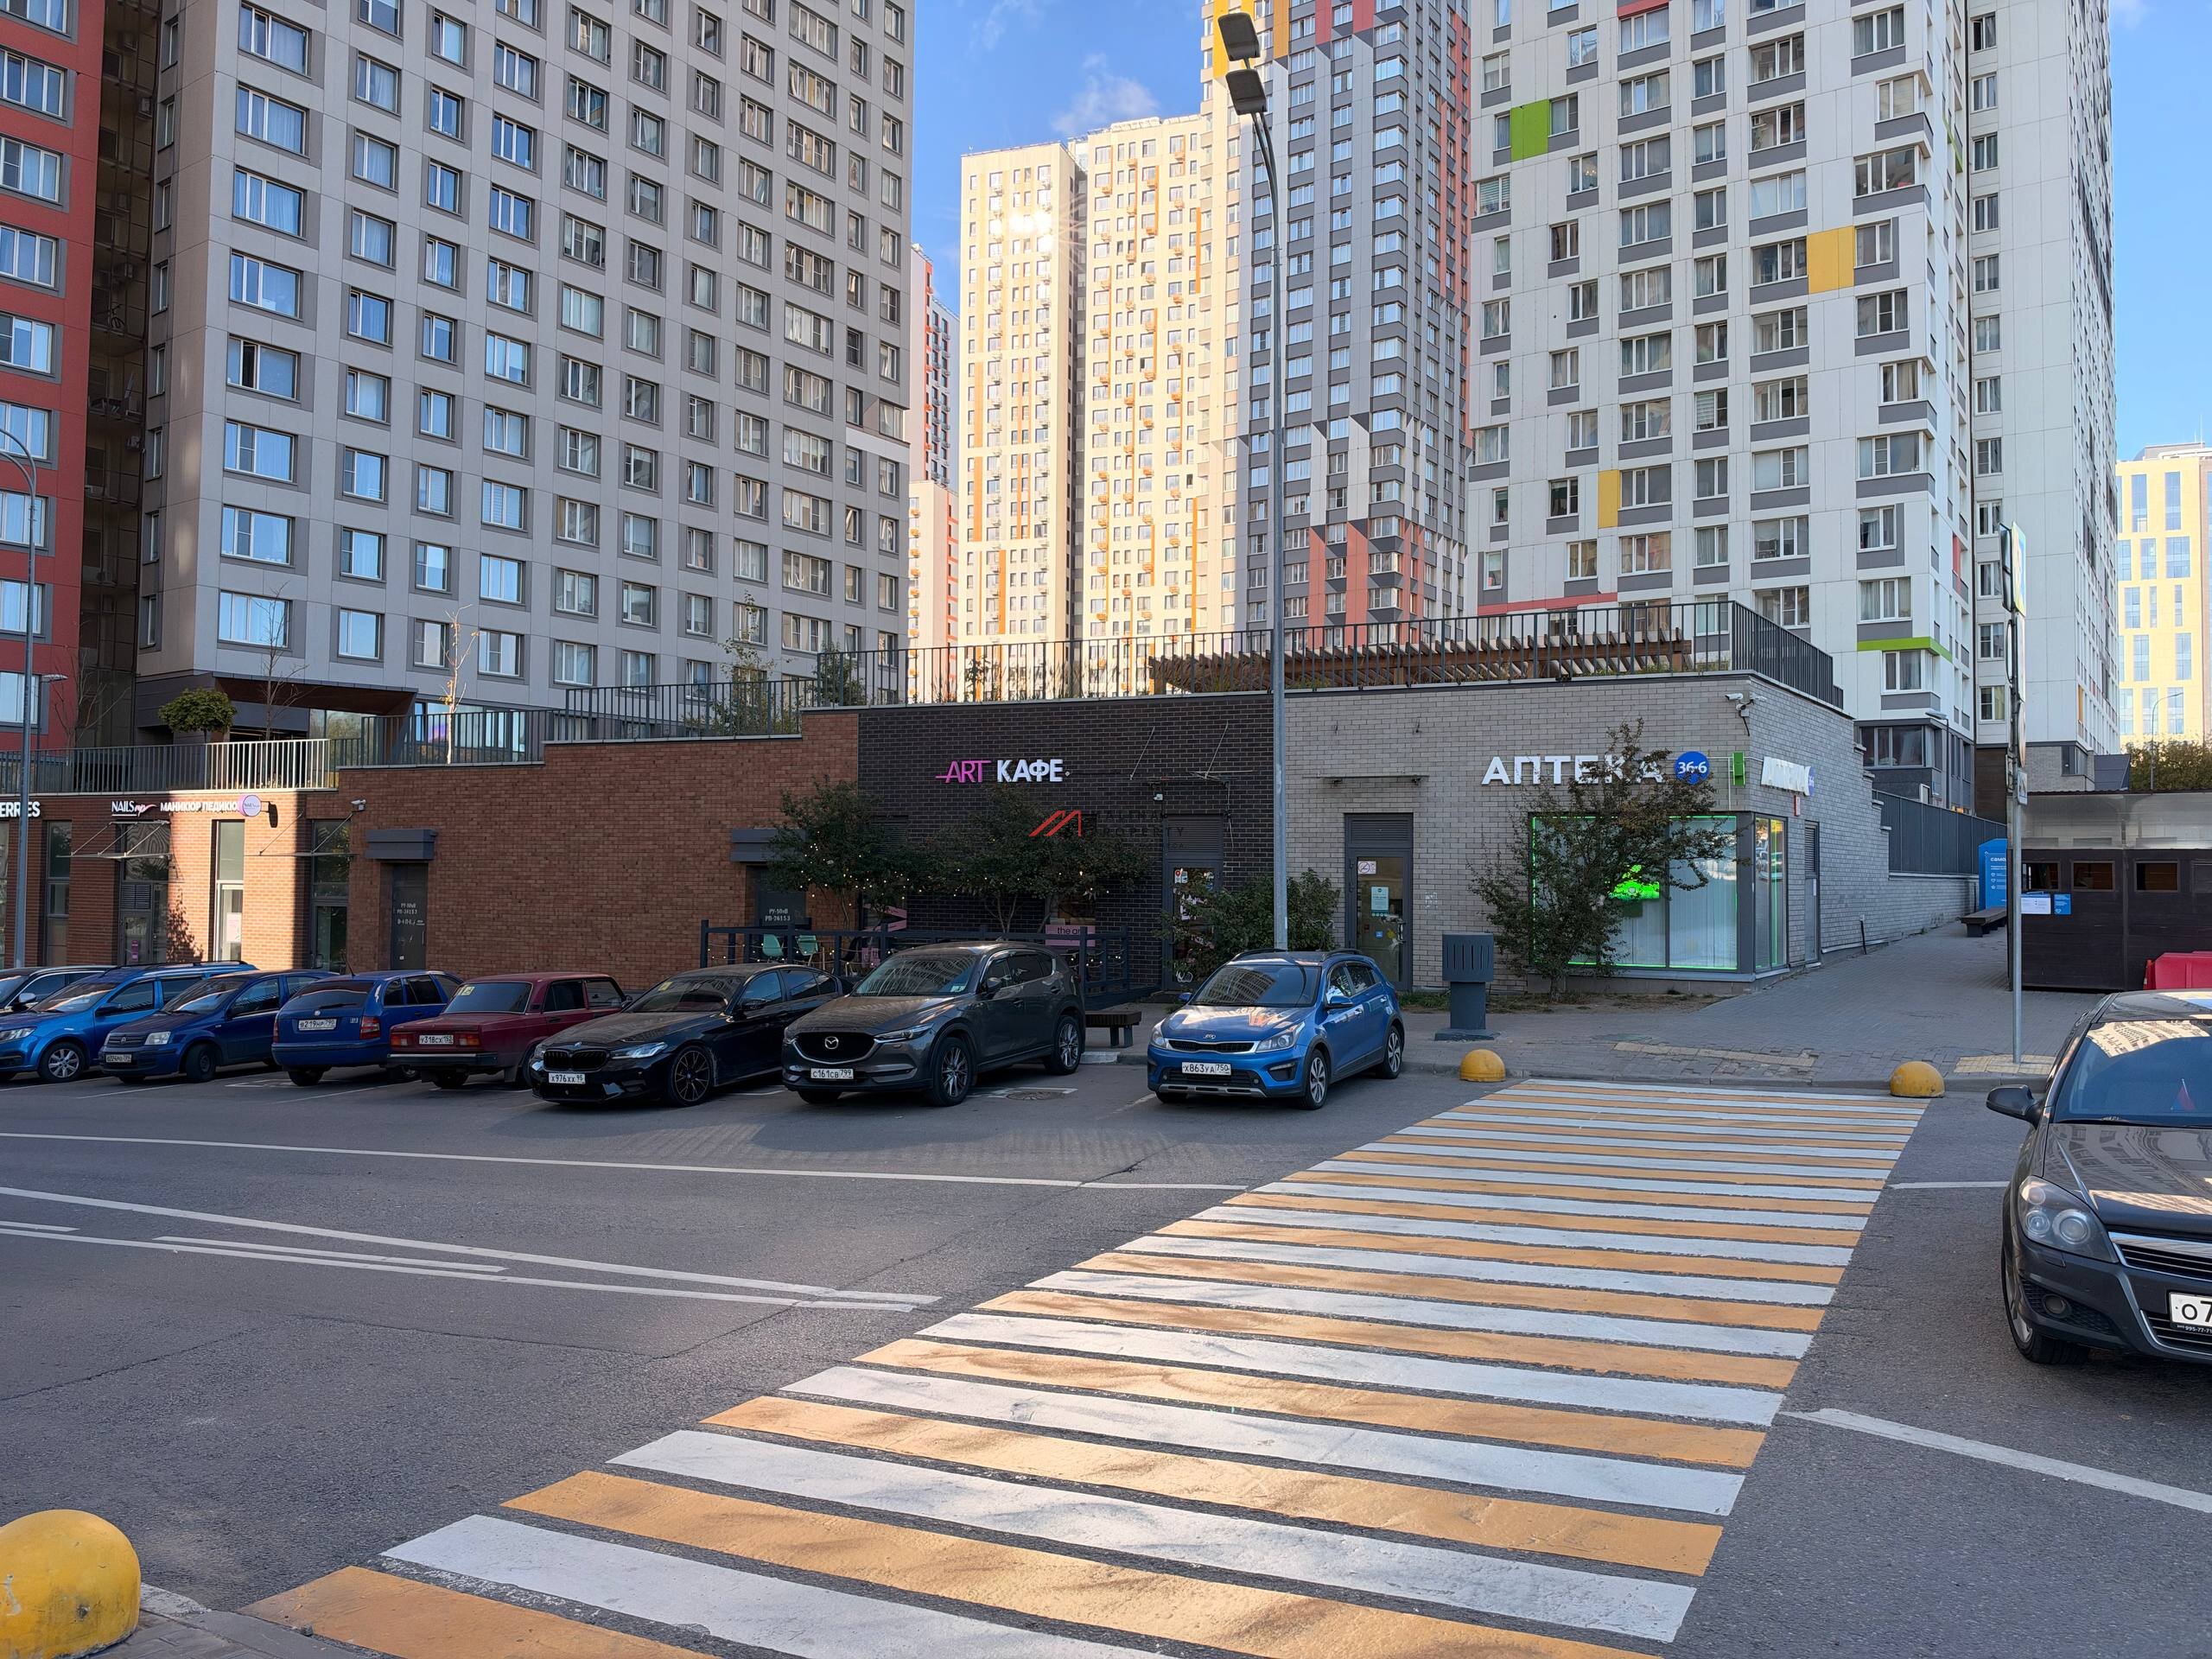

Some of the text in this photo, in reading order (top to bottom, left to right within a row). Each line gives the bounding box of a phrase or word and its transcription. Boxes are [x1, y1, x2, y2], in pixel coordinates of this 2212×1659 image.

[936, 760, 1064, 783] ART КАФЕ
[1481, 755, 1665, 785] АПТЕКА
[0, 802, 41, 817] ERRES
[111, 800, 135, 813] NAILS
[160, 802, 201, 812] МАНИКЮР
[201, 801, 239, 812] ПЕДИКЮ
[1183, 1064, 1215, 1072] Х863УА
